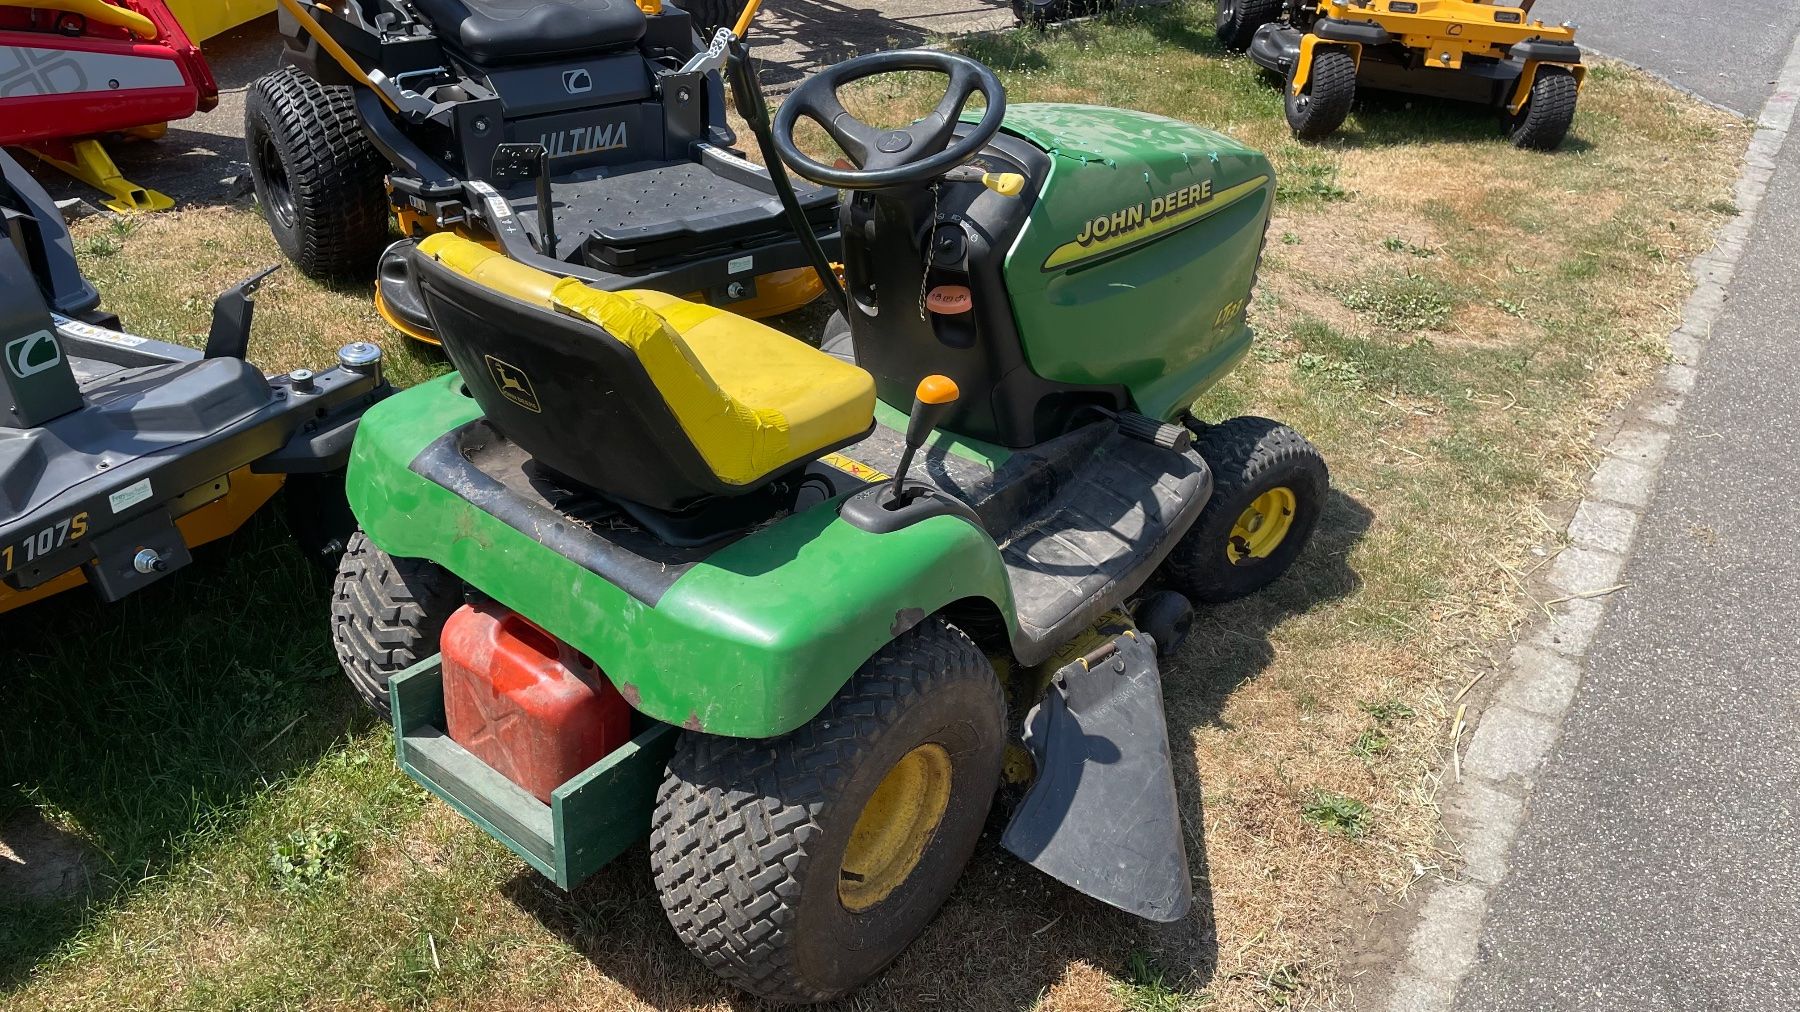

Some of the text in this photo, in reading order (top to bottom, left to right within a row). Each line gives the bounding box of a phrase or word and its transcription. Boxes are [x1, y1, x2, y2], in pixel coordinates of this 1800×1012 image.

[539, 121, 628, 159] ULTIMA
[1076, 179, 1214, 247] JOHN DEERE
[23, 511, 89, 562] 107S
